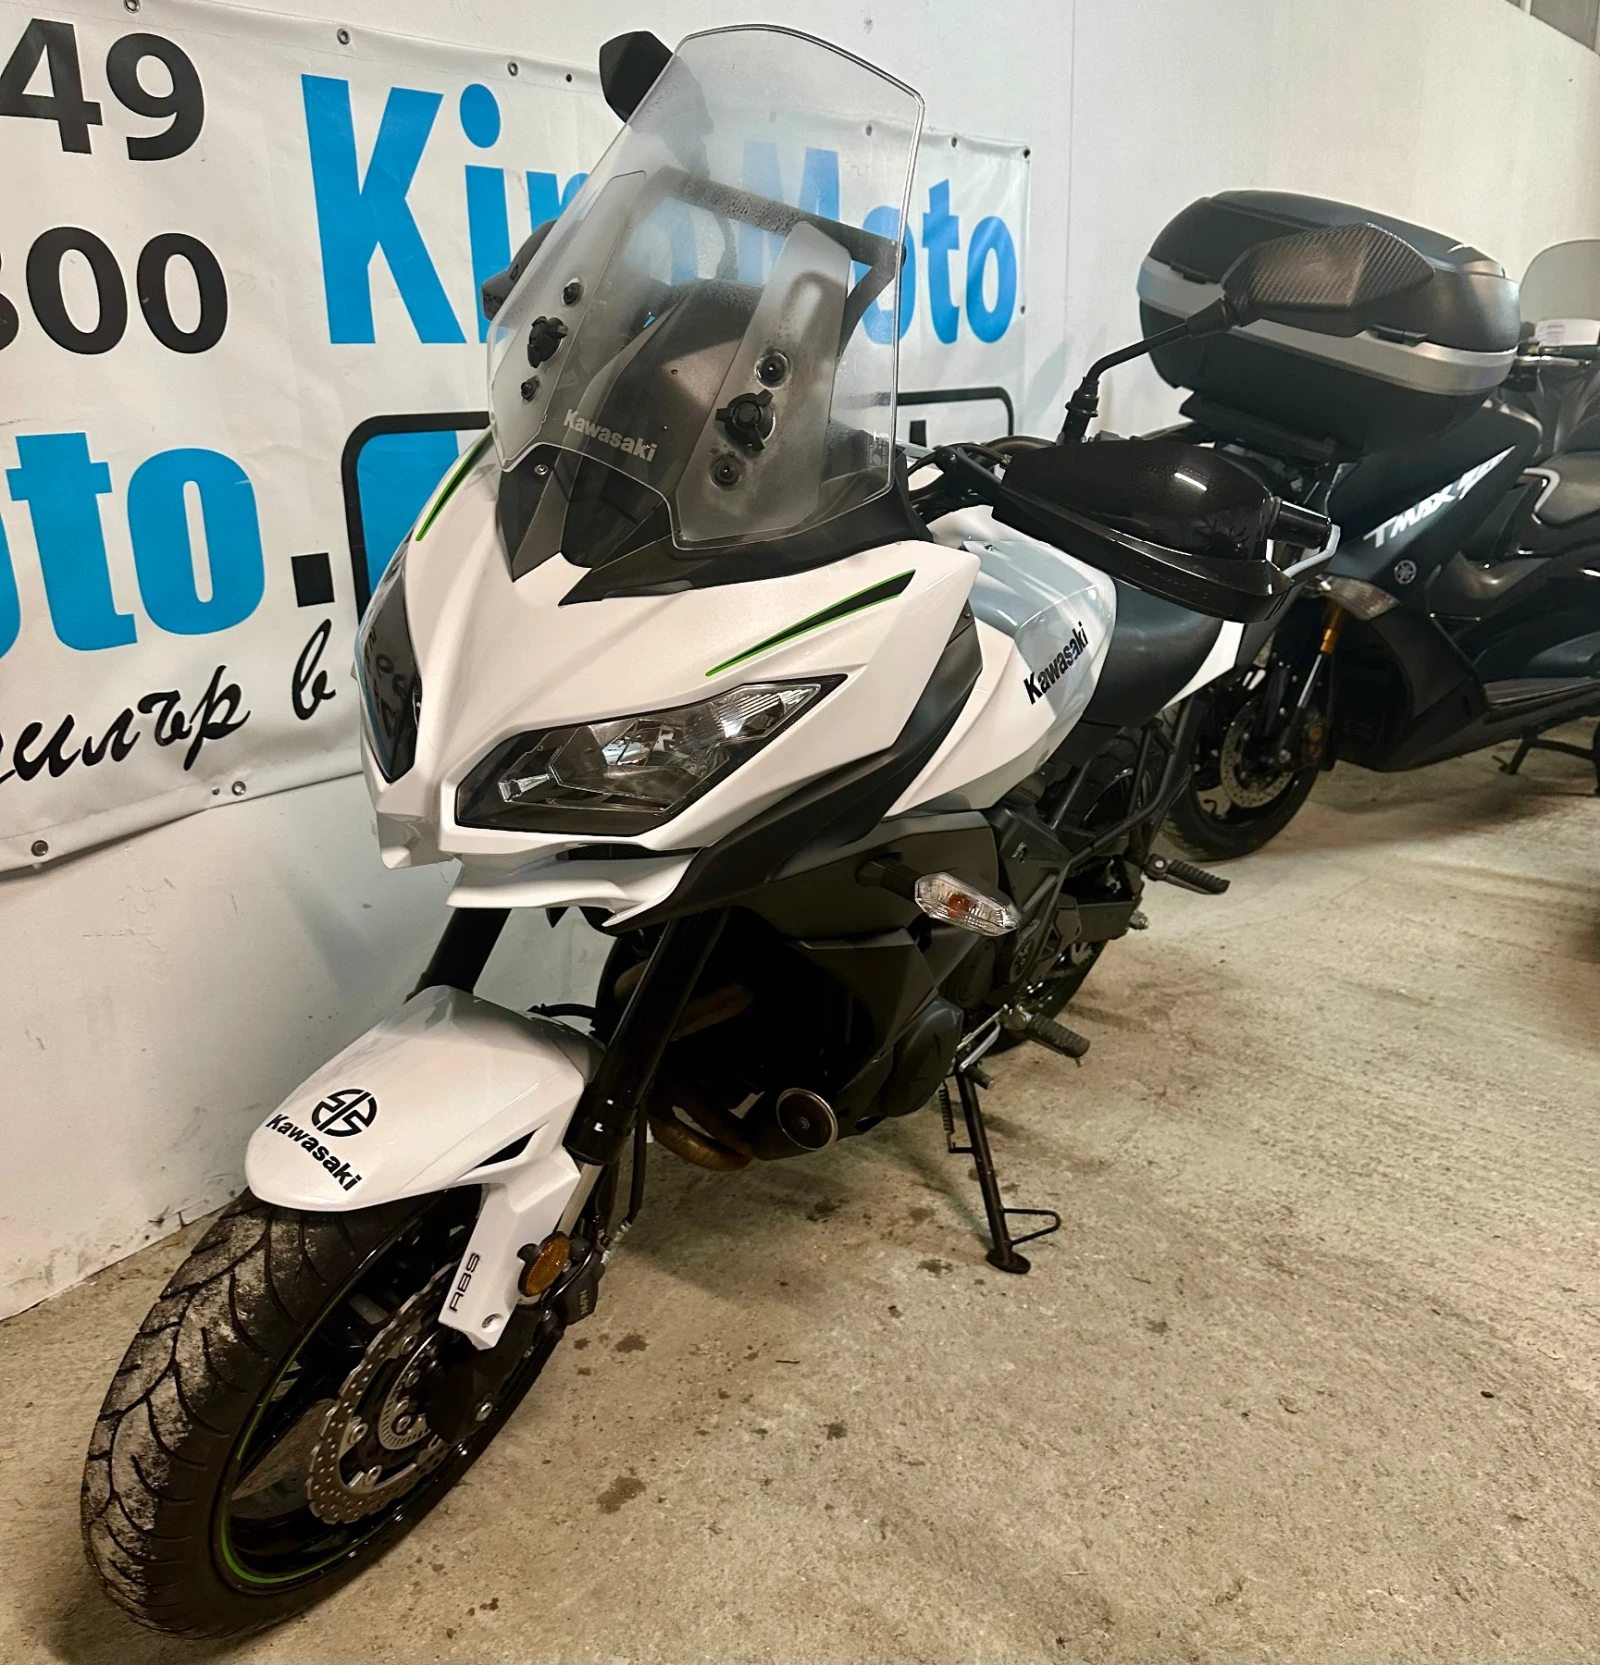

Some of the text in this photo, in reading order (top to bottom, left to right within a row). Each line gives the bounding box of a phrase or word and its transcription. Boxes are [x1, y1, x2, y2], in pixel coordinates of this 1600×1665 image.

[0, 225, 228, 355] 00
[563, 408, 658, 462] Kawasaki
[0, 432, 336, 657] to.
[1363, 483, 1457, 548] TMAX
[1023, 620, 1089, 705] Kawasaki
[0, 664, 251, 784] илър
[265, 1113, 363, 1192] Kawasaki
[449, 1253, 481, 1312] ABS
